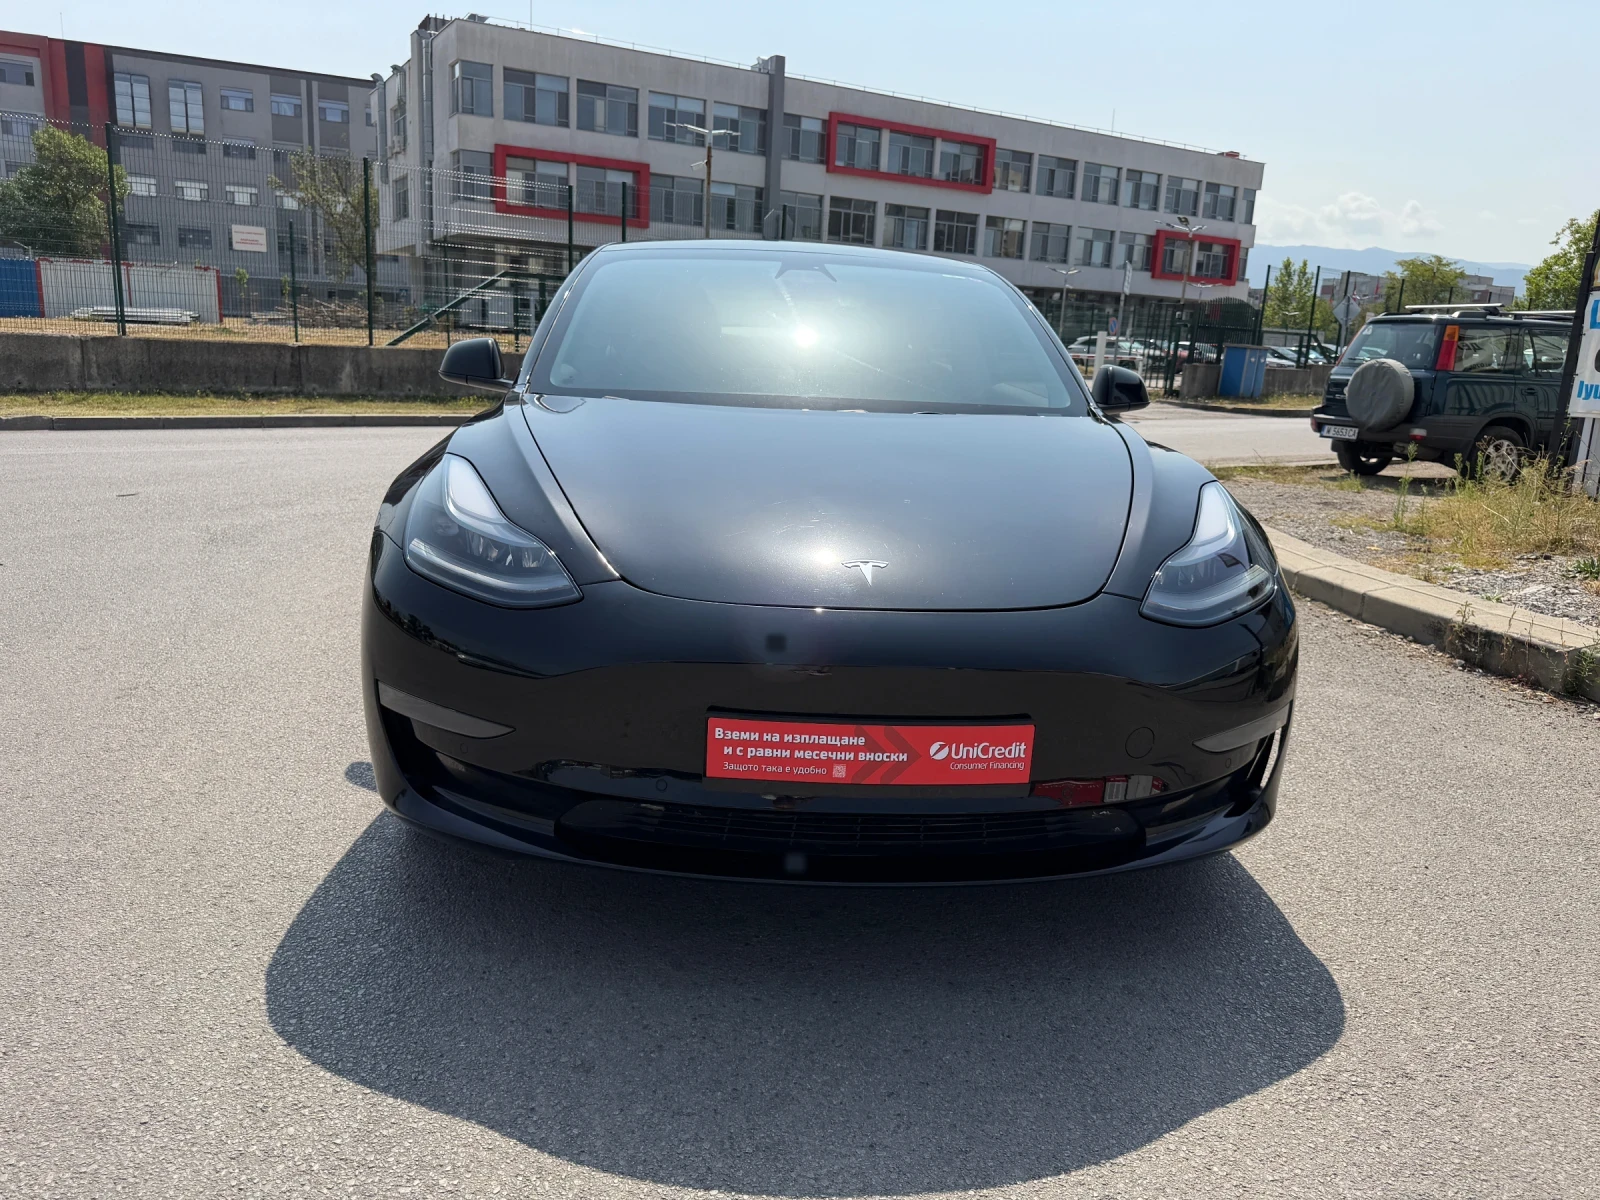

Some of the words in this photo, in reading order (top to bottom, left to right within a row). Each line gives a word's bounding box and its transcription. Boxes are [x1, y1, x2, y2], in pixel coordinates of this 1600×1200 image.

[714, 727, 759, 741] Вземи
[763, 732, 780, 742] на
[783, 734, 866, 747] изплащане
[723, 746, 732, 755] и
[736, 746, 744, 756] с
[747, 746, 790, 759] равни
[794, 749, 855, 760] месечни
[858, 752, 908, 762] вноски
[951, 742, 1027, 759] UniCredit
[723, 761, 759, 772] Защото
[761, 764, 783, 773] така
[793, 766, 827, 775] удобно
[950, 761, 988, 770] Consumer
[989, 761, 1025, 771] Financing
